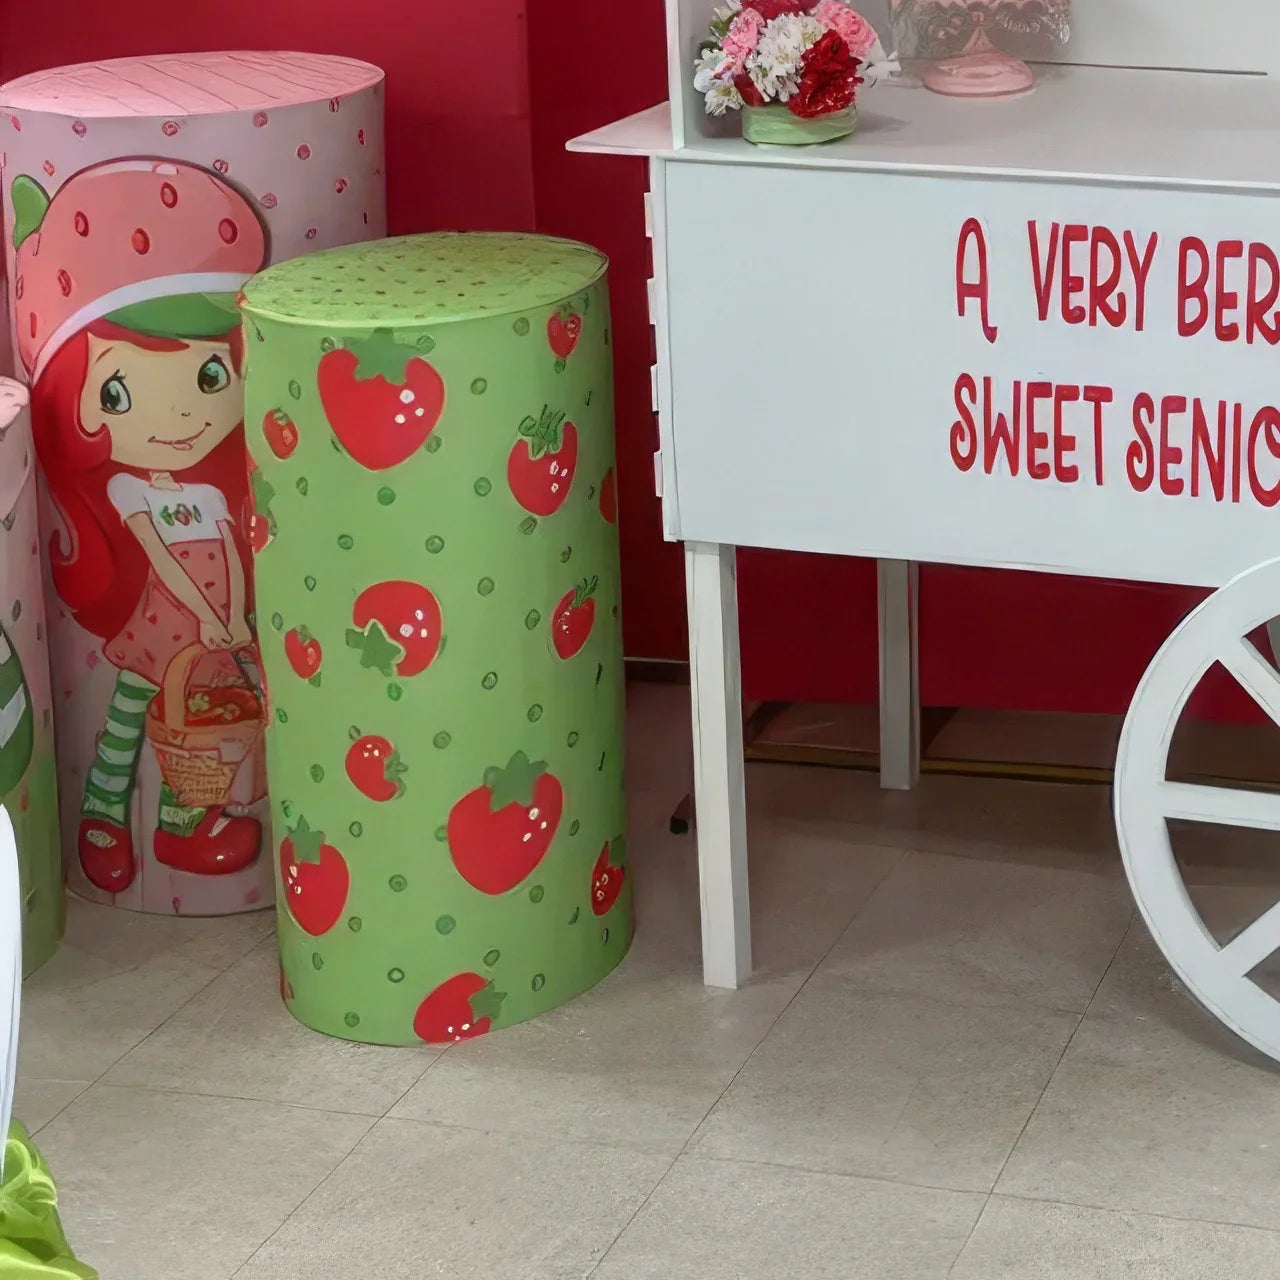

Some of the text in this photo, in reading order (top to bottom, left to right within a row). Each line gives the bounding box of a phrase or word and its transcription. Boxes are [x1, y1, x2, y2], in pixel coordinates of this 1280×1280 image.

[956, 217, 998, 344] A
[1028, 220, 1158, 331] VERY
[950, 372, 1113, 485] SWEET
